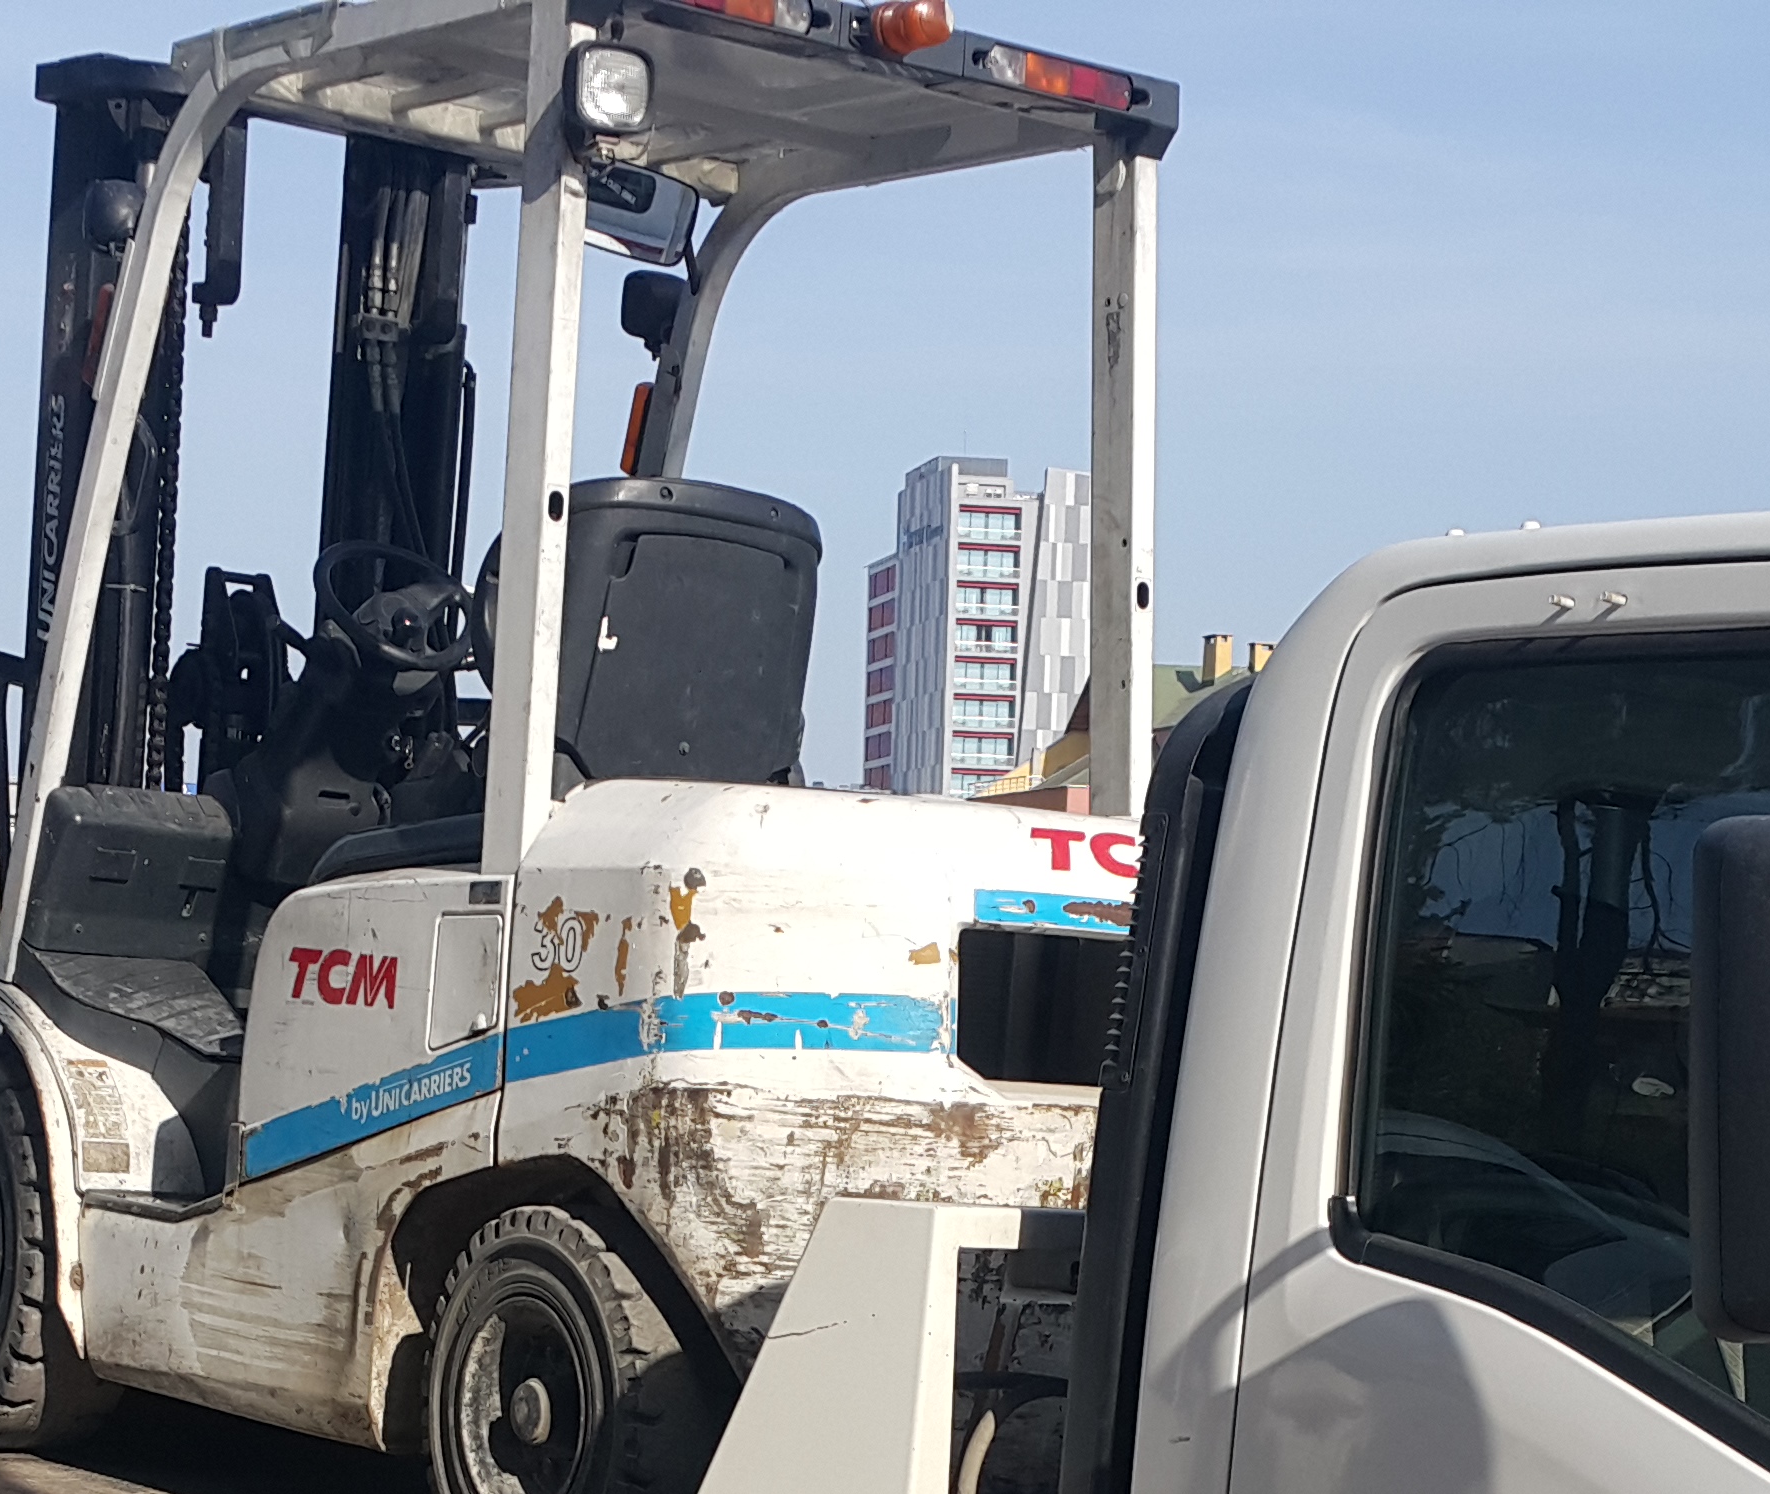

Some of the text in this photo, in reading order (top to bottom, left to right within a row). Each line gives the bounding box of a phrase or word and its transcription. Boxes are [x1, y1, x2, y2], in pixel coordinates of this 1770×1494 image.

[1030, 827, 1140, 879] TC
[289, 946, 399, 1009] TCM
[351, 1061, 472, 1124] by UNICARRIERS
